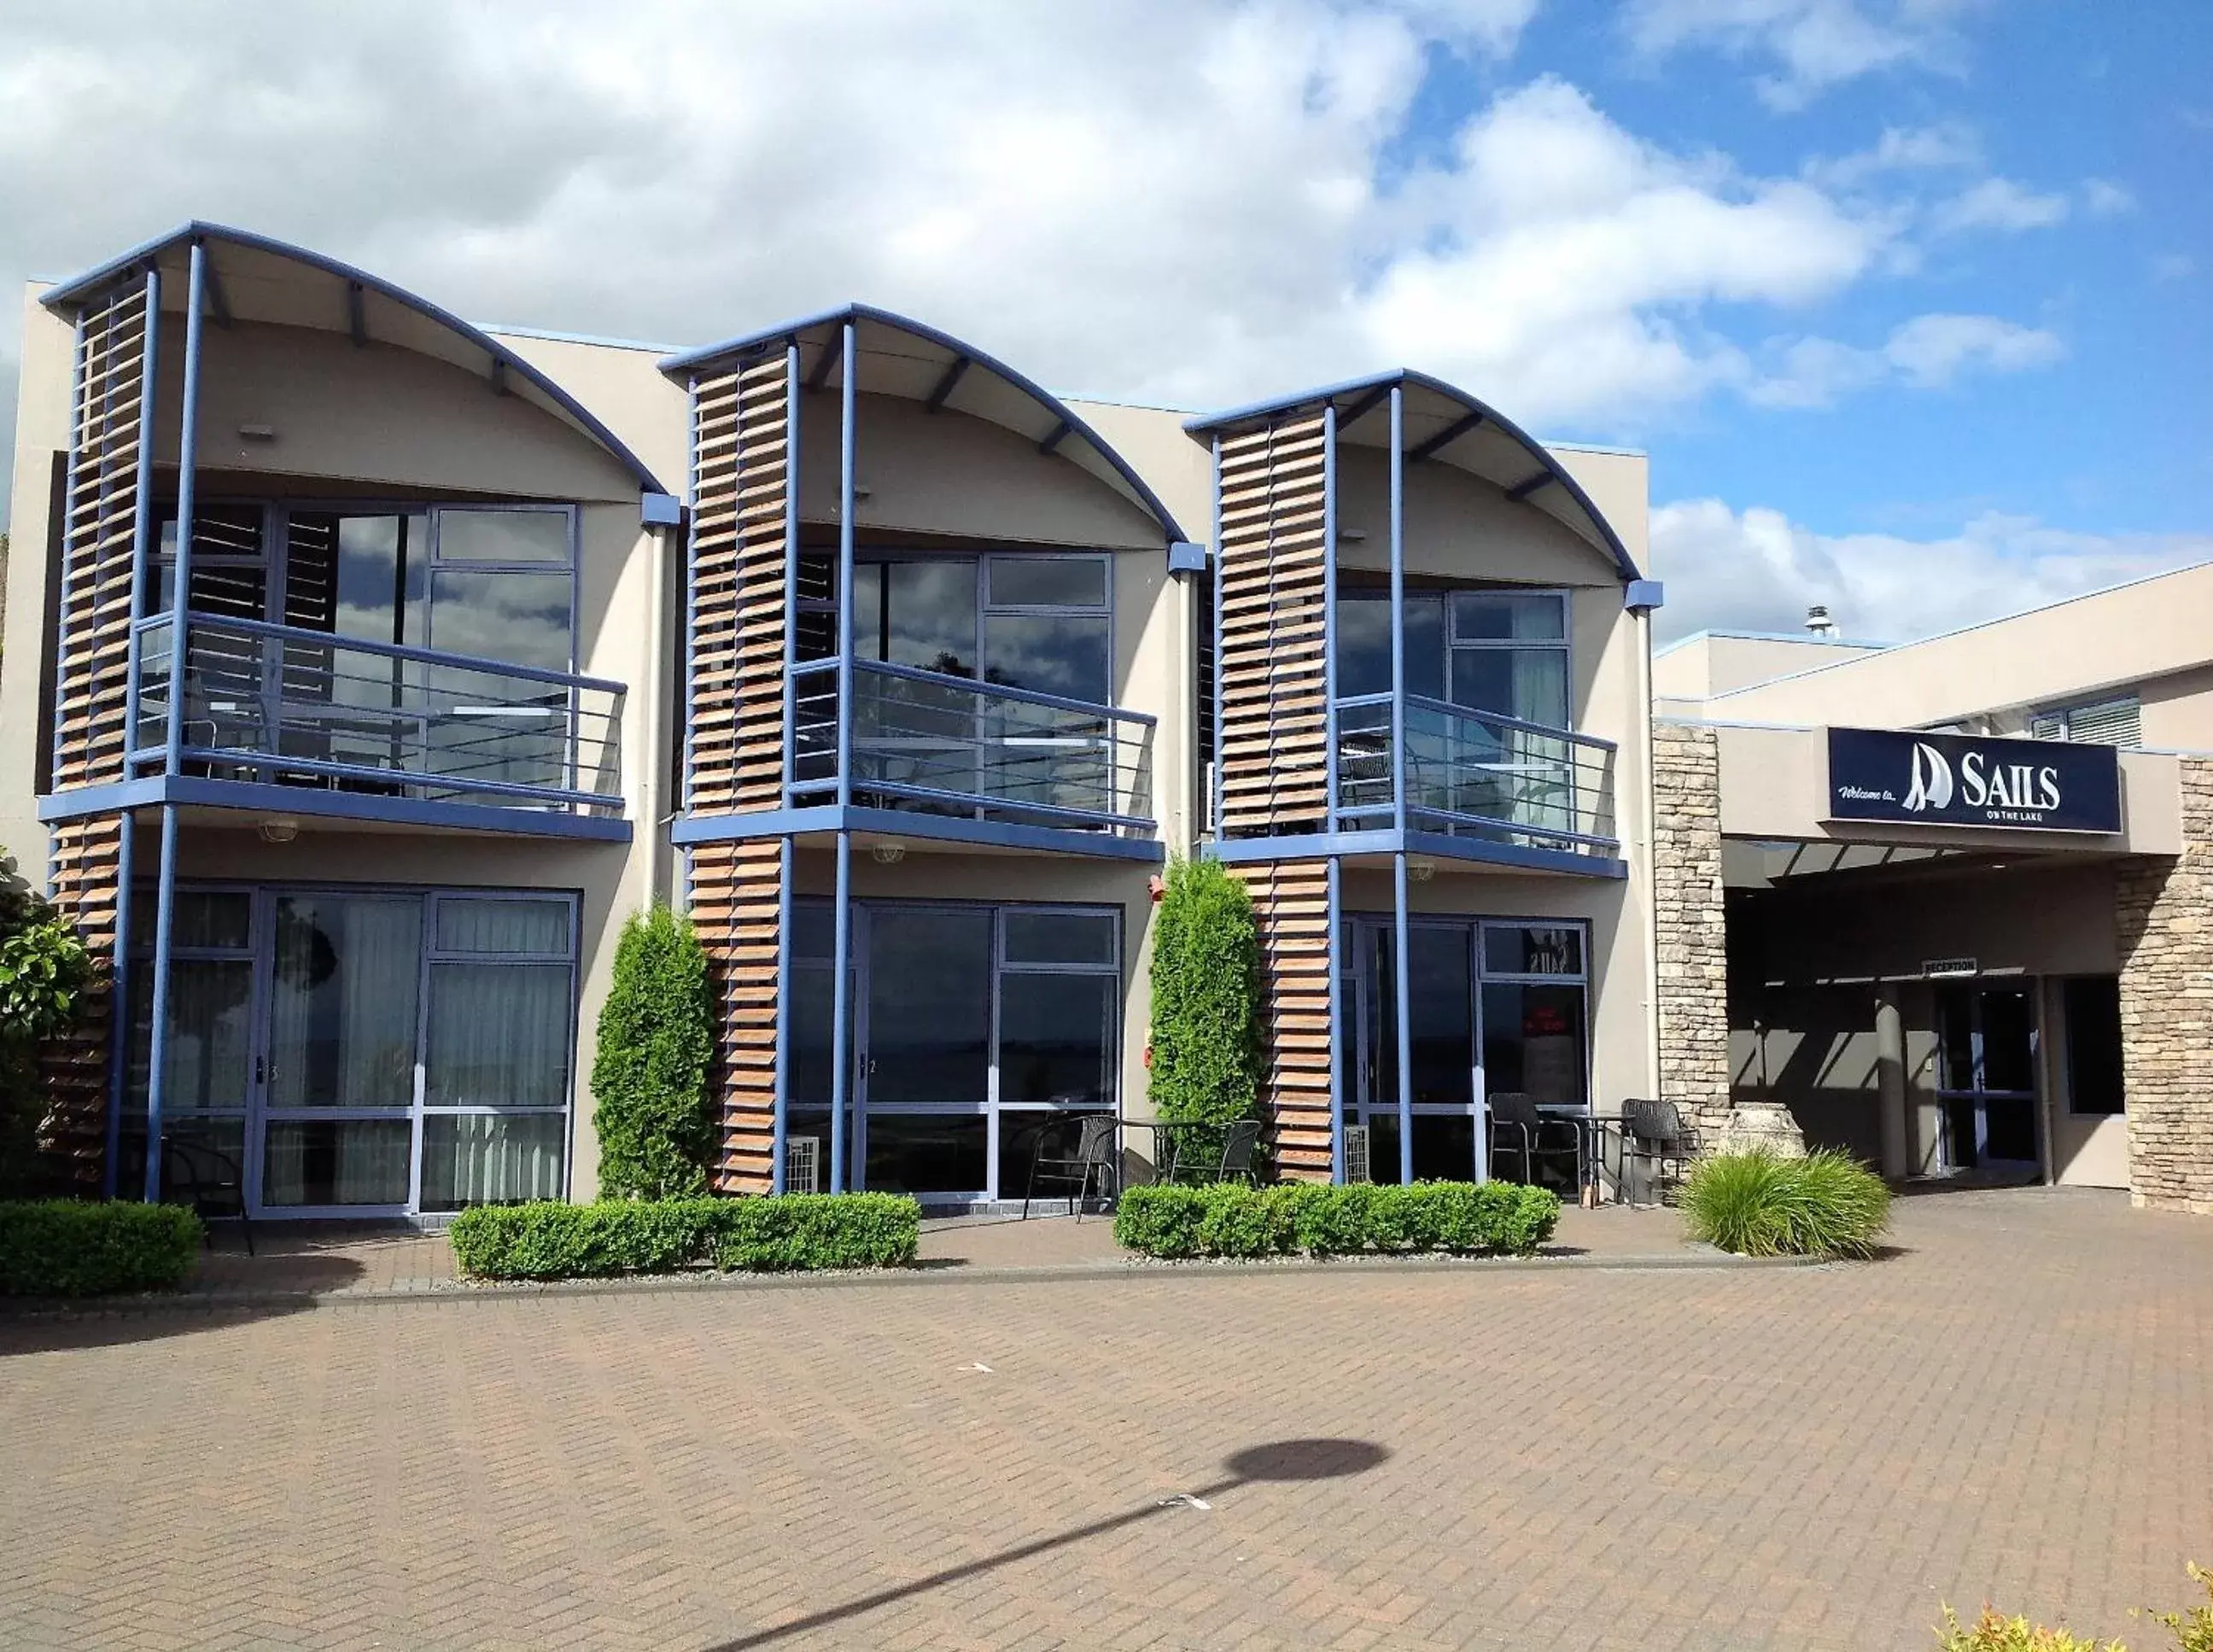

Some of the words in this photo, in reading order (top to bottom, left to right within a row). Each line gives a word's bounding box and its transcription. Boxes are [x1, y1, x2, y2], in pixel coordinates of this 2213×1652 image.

[1961, 751, 2060, 810] SAILS
[1838, 785, 1881, 800] Welcome
[1987, 810, 2000, 820] ON
[2000, 810, 2018, 820] THE
[1925, 960, 1975, 972] RECEPTION
